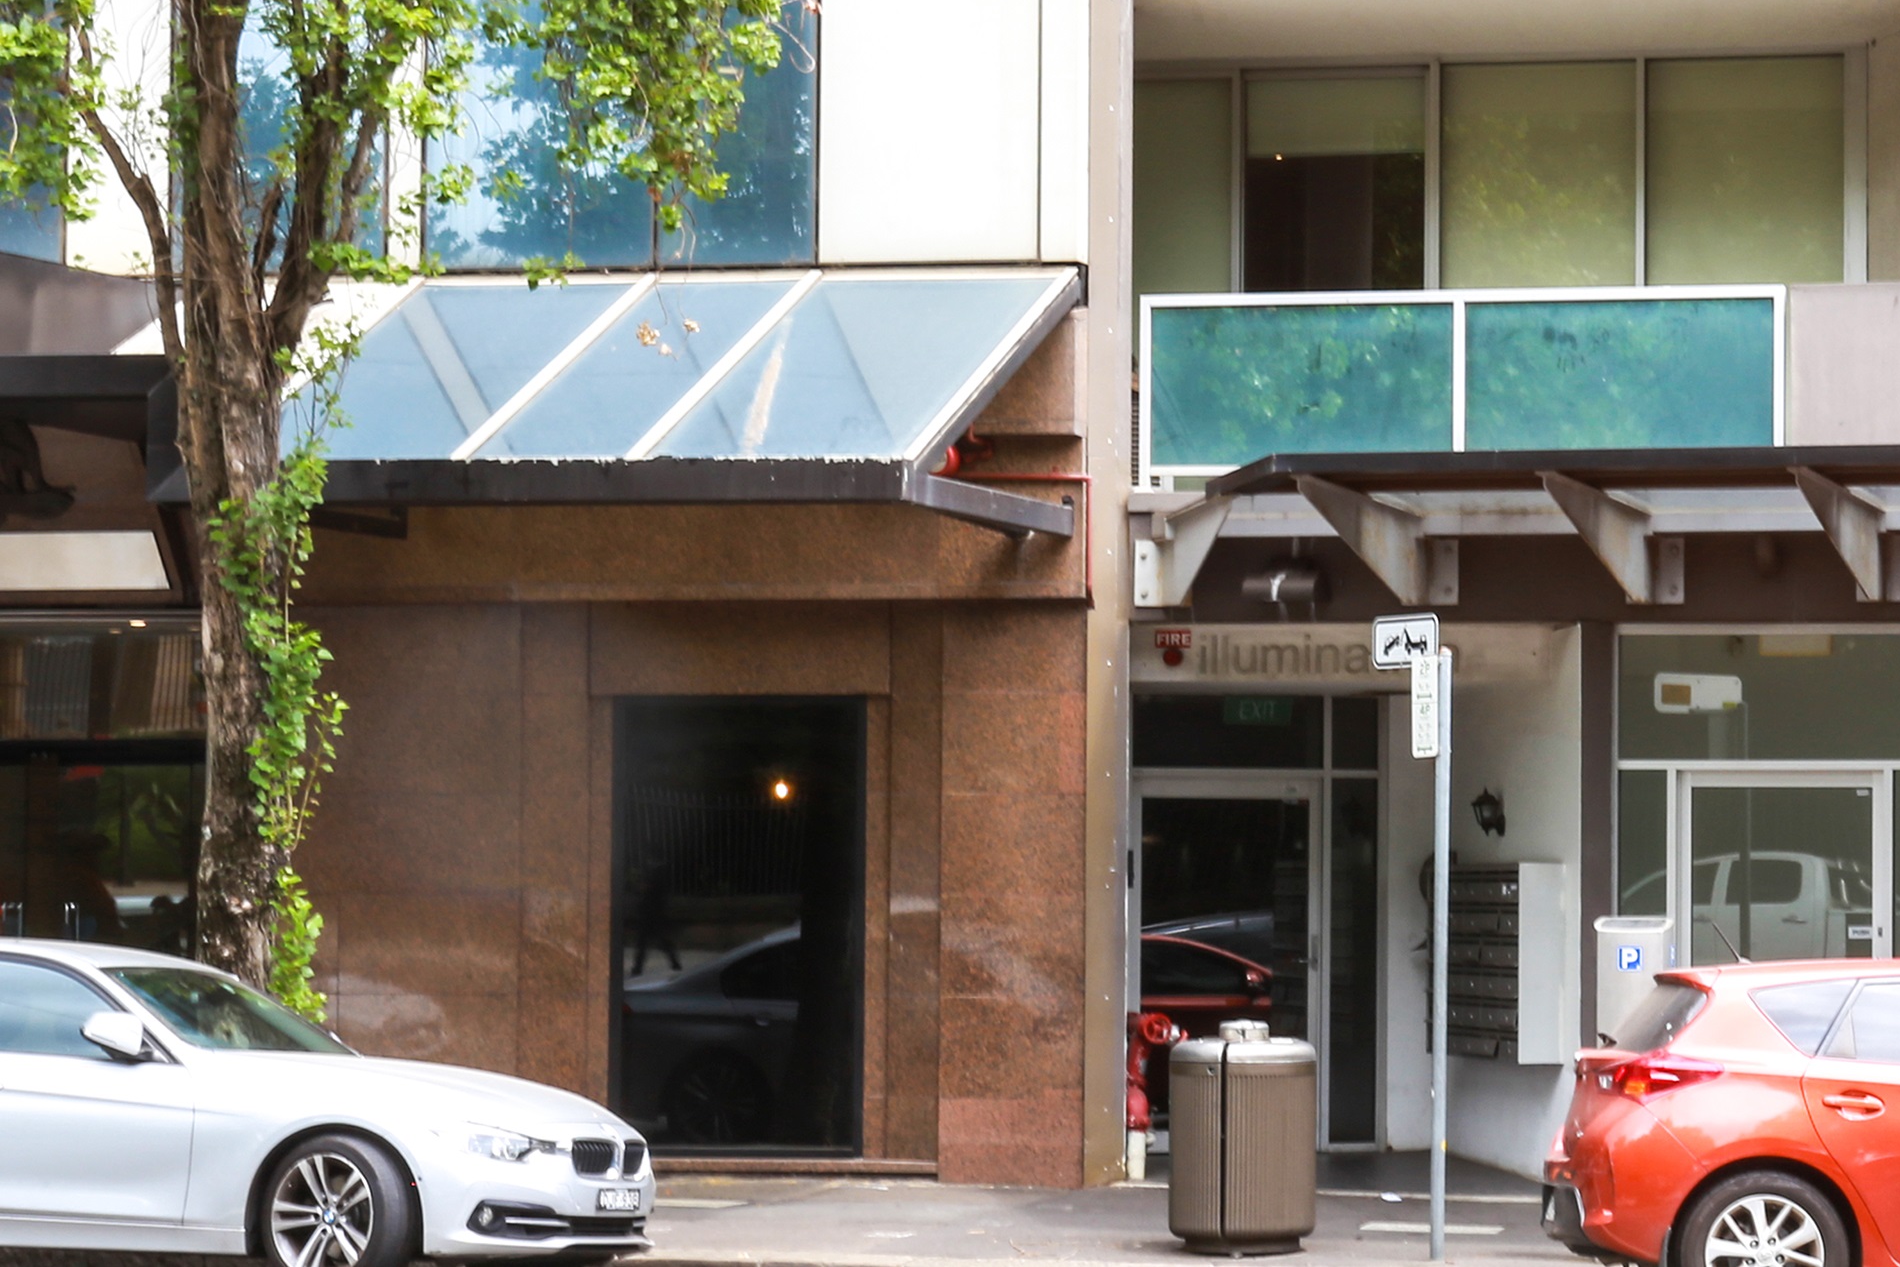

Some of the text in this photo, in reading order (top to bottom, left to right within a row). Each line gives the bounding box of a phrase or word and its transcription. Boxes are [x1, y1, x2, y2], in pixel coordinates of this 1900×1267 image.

[1156, 634, 1191, 648] FIRE
[1200, 635, 1460, 675] illuminan
[1238, 700, 1276, 720] EXIT
[1621, 947, 1639, 970] P
